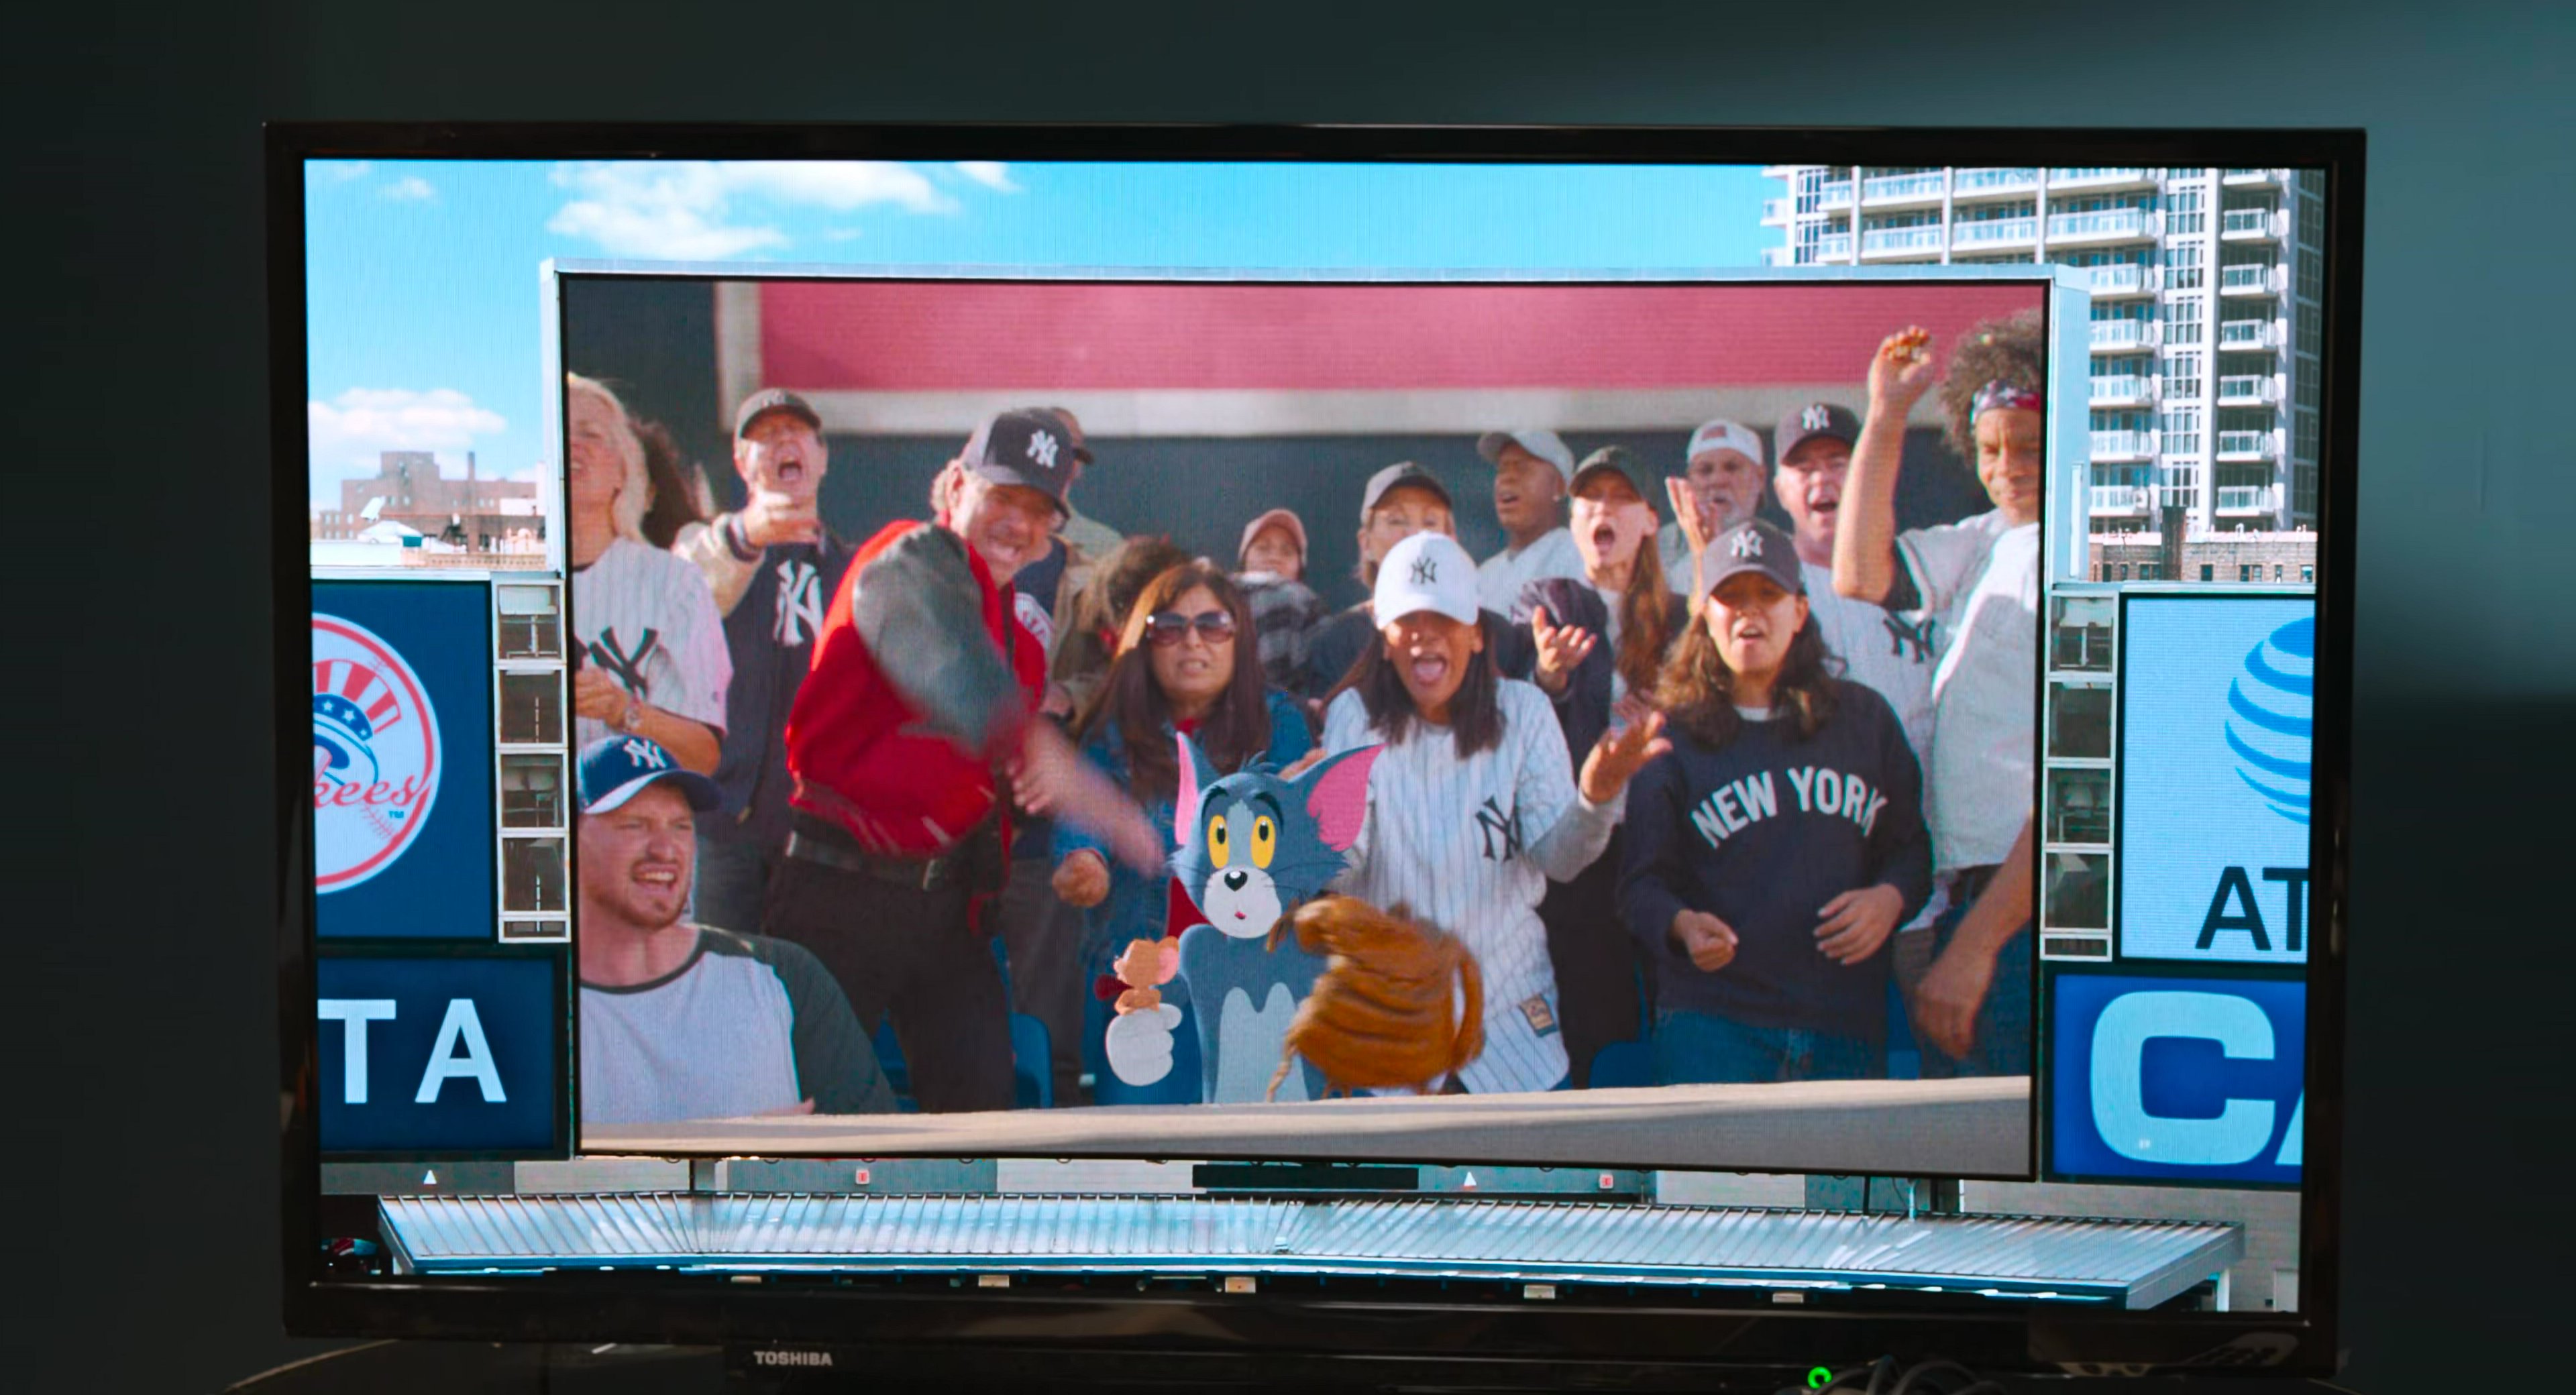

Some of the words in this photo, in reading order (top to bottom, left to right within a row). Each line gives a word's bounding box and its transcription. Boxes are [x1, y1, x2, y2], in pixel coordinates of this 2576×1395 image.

[1802, 405, 1831, 430] NY
[1027, 430, 1058, 467] NY
[1730, 530, 1764, 559] NY
[1409, 556, 1438, 585] NY
[623, 739, 665, 769] NY
[1690, 771, 1778, 850] NEW
[1785, 765, 1888, 838] YORK
[1475, 793, 1523, 862] NY
[317, 999, 507, 1104] TA
[753, 1350, 833, 1366] TOSHIBA
